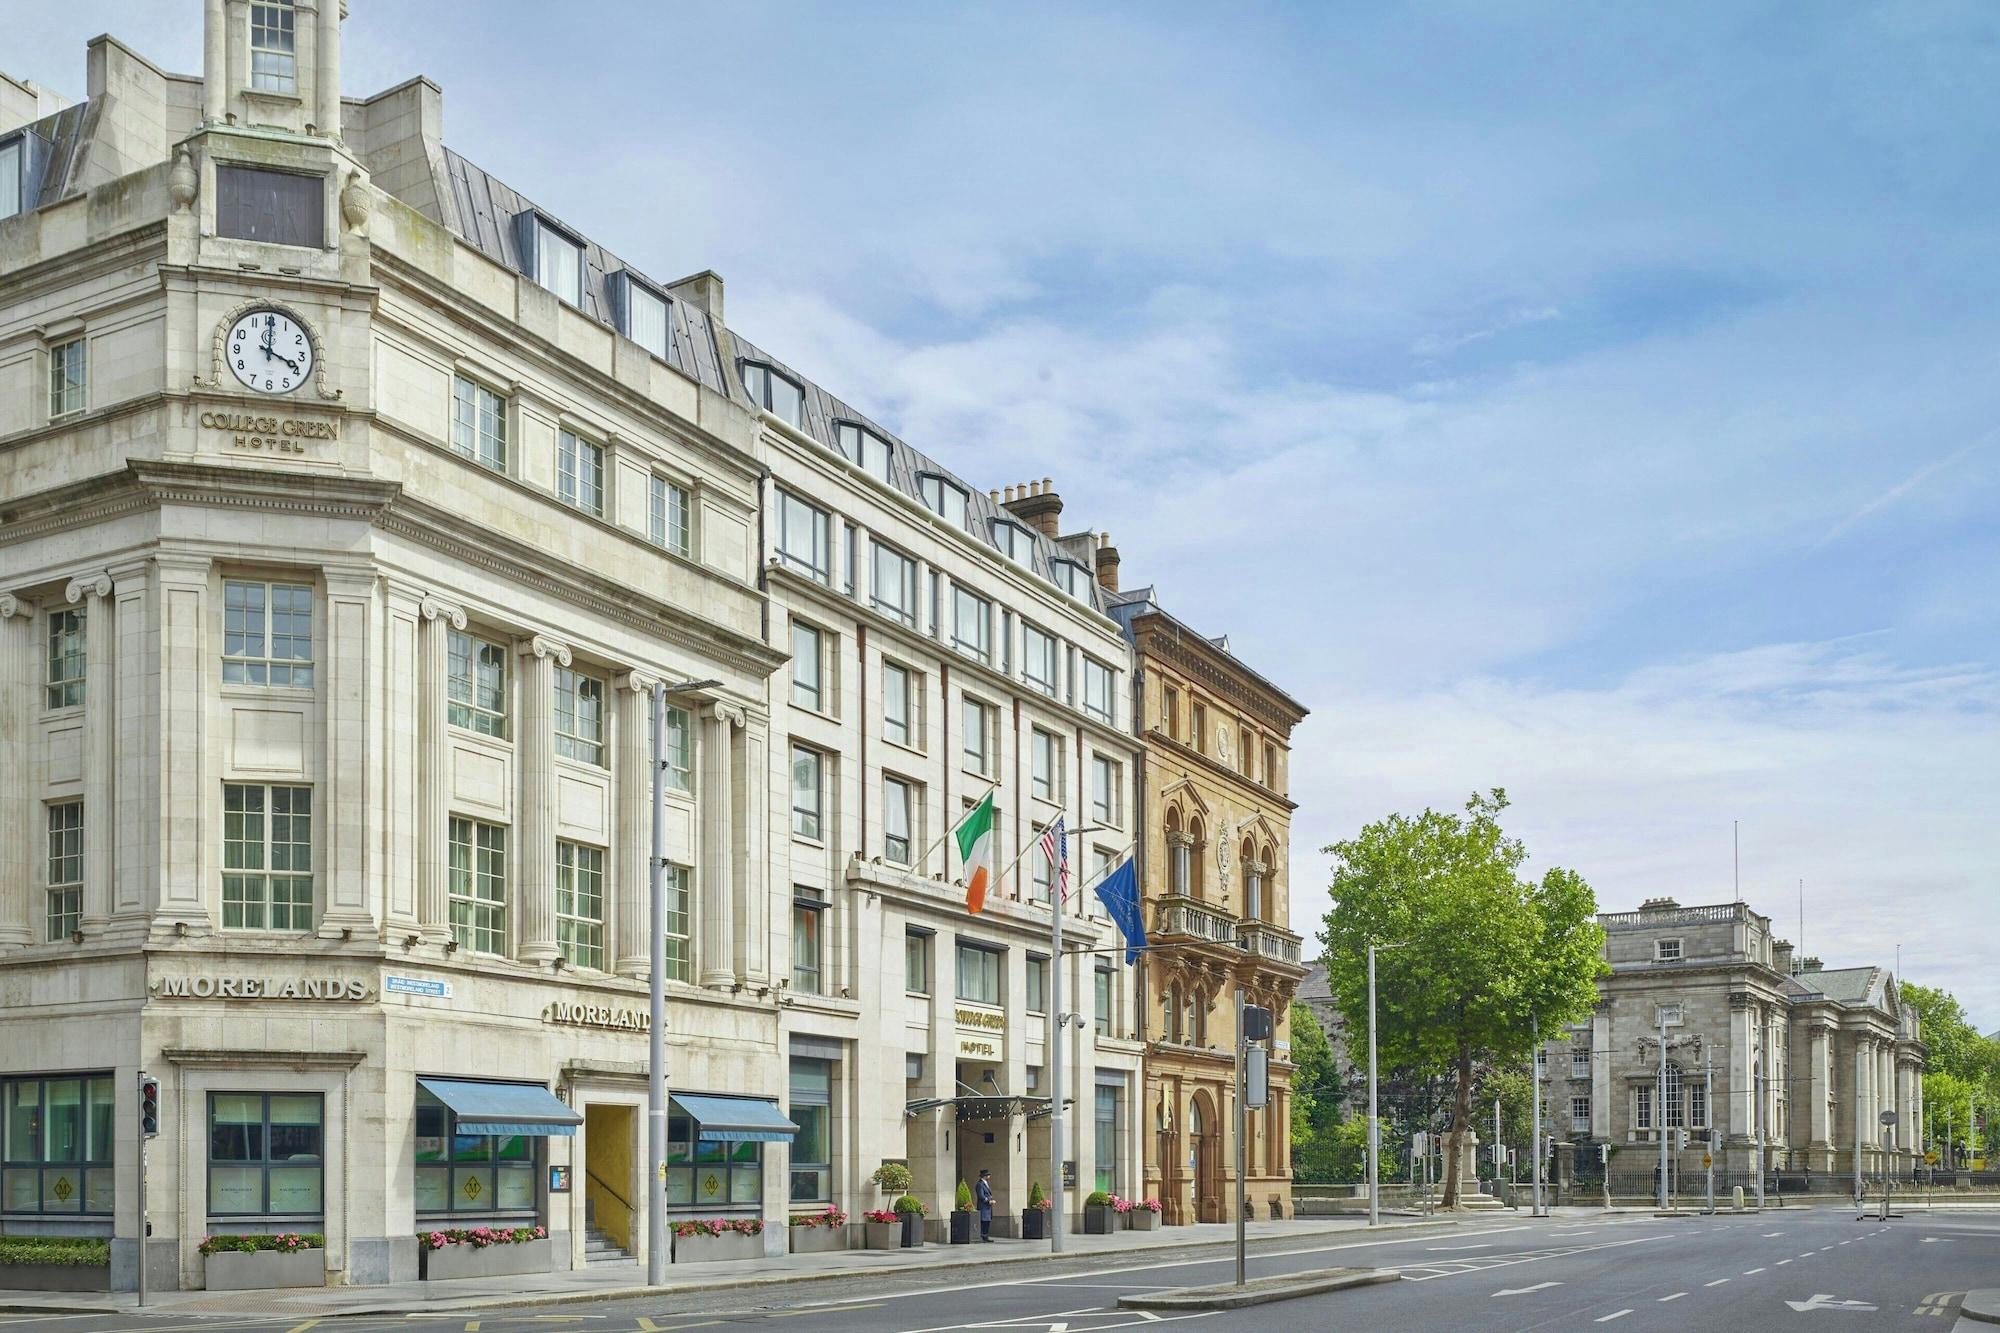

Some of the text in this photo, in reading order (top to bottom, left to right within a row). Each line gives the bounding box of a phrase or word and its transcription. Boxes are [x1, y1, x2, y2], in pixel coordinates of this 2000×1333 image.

[251, 317, 258, 328] 11
[236, 329, 247, 340] 10
[295, 334, 303, 345] 2
[233, 343, 241, 354] 9
[298, 351, 306, 362] 3
[237, 360, 245, 370] 8
[293, 367, 300, 377] 4
[250, 374, 257, 385] 7
[266, 380, 273, 390] 6
[282, 378, 290, 389] 5
[201, 411, 338, 441] COLLEGE GREEN
[235, 436, 304, 453] HOTEL
[162, 975, 367, 1000] MORELANDS
[556, 1002, 651, 1029] MORELAND
